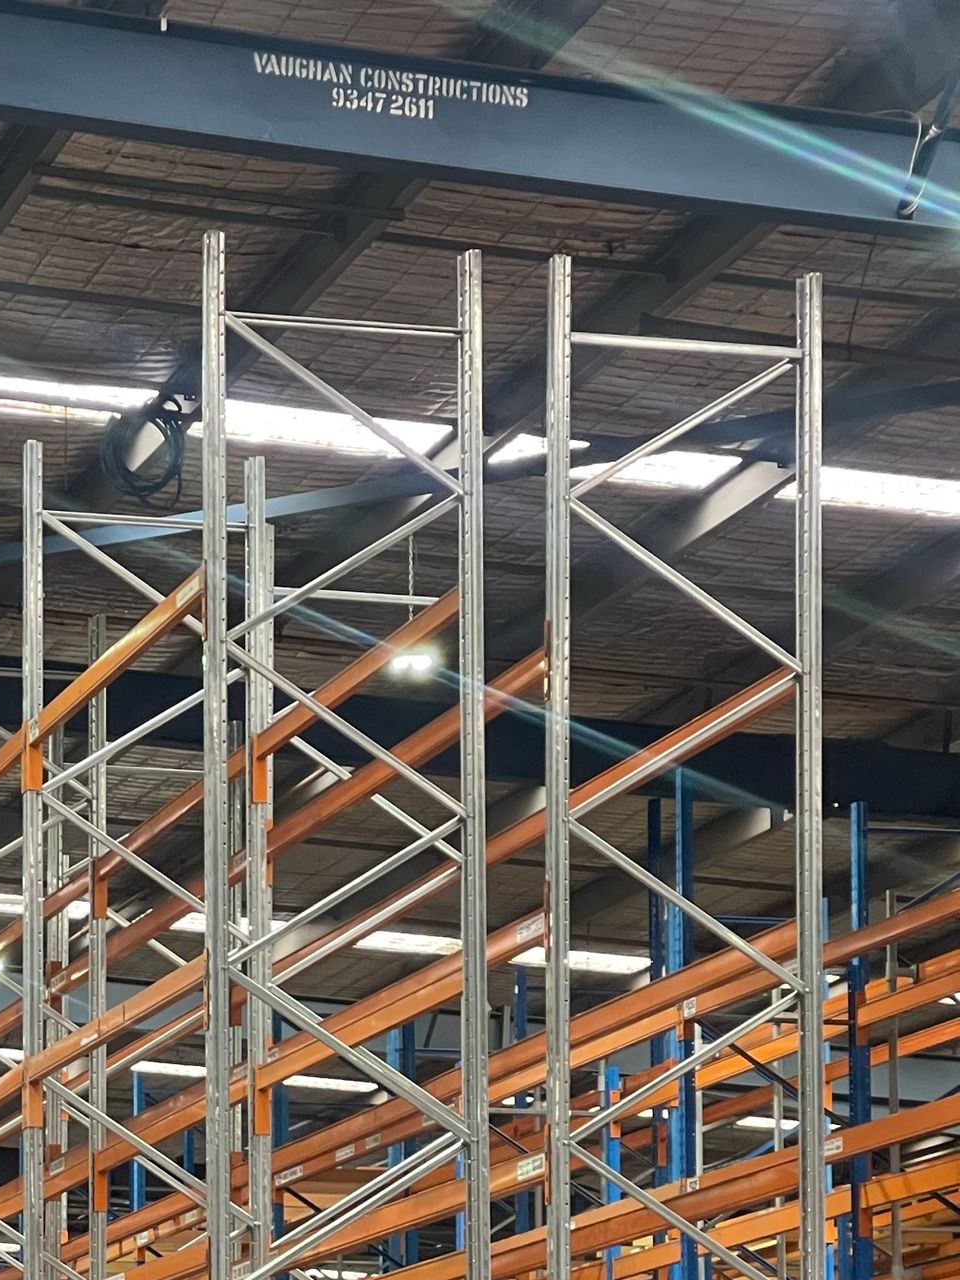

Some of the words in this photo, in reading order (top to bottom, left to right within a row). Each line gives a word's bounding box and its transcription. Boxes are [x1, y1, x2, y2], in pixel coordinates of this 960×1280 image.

[253, 52, 352, 84] VAUGHAN
[360, 67, 529, 108] CONSTRUCTIONS
[332, 87, 387, 113] 9347
[390, 95, 434, 119] 2611
